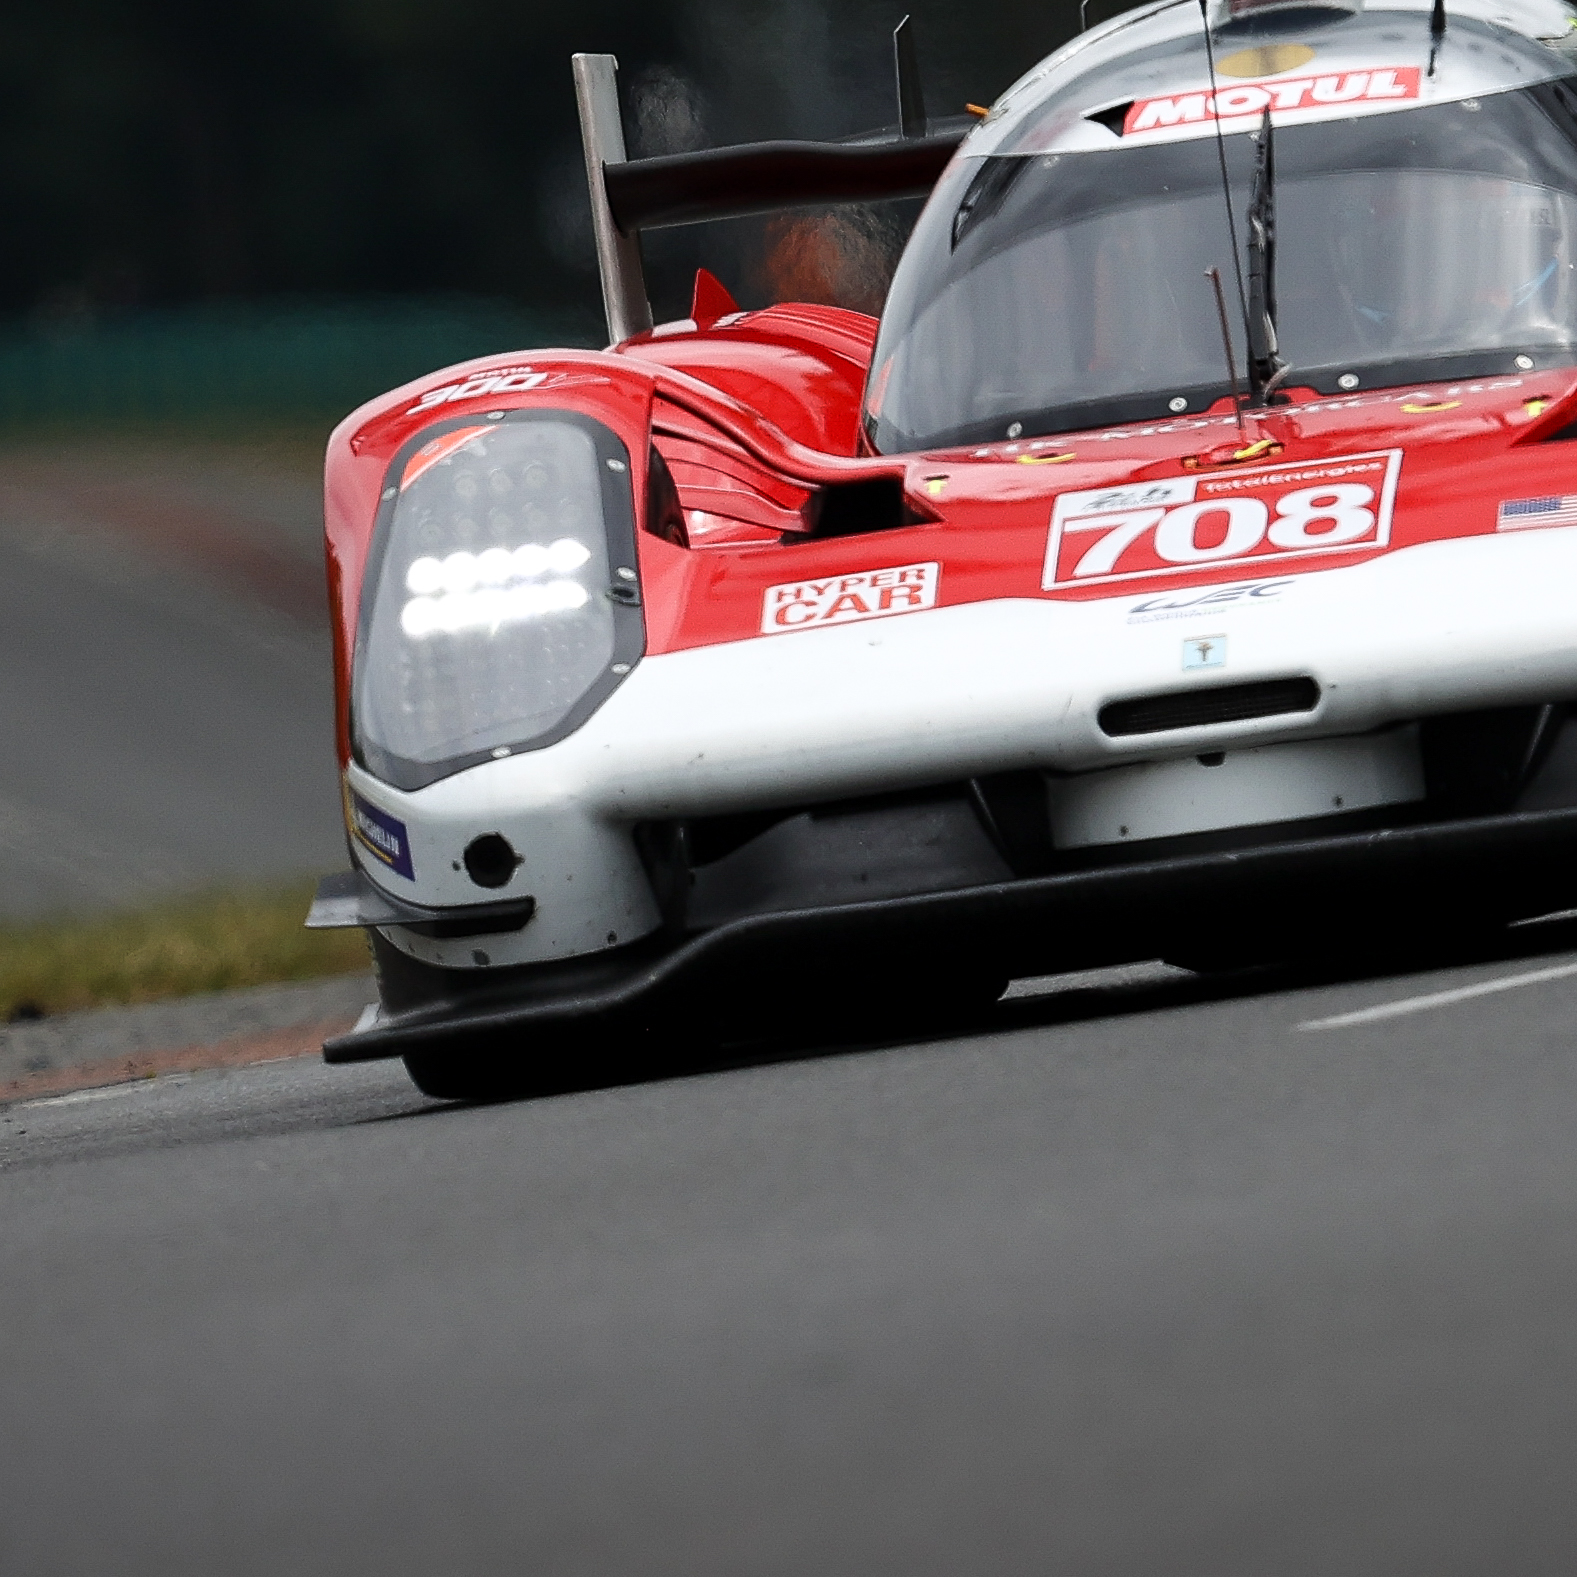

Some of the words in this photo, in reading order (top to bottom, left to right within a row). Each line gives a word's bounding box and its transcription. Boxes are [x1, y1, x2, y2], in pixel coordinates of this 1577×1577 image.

[1130, 69, 1408, 130] MOTUL
[1202, 460, 1383, 494] TotalEnergies
[1063, 482, 1376, 577] 708
[775, 568, 926, 604] HYPER
[775, 584, 924, 625] CAR
[1128, 579, 1297, 614] WEC
